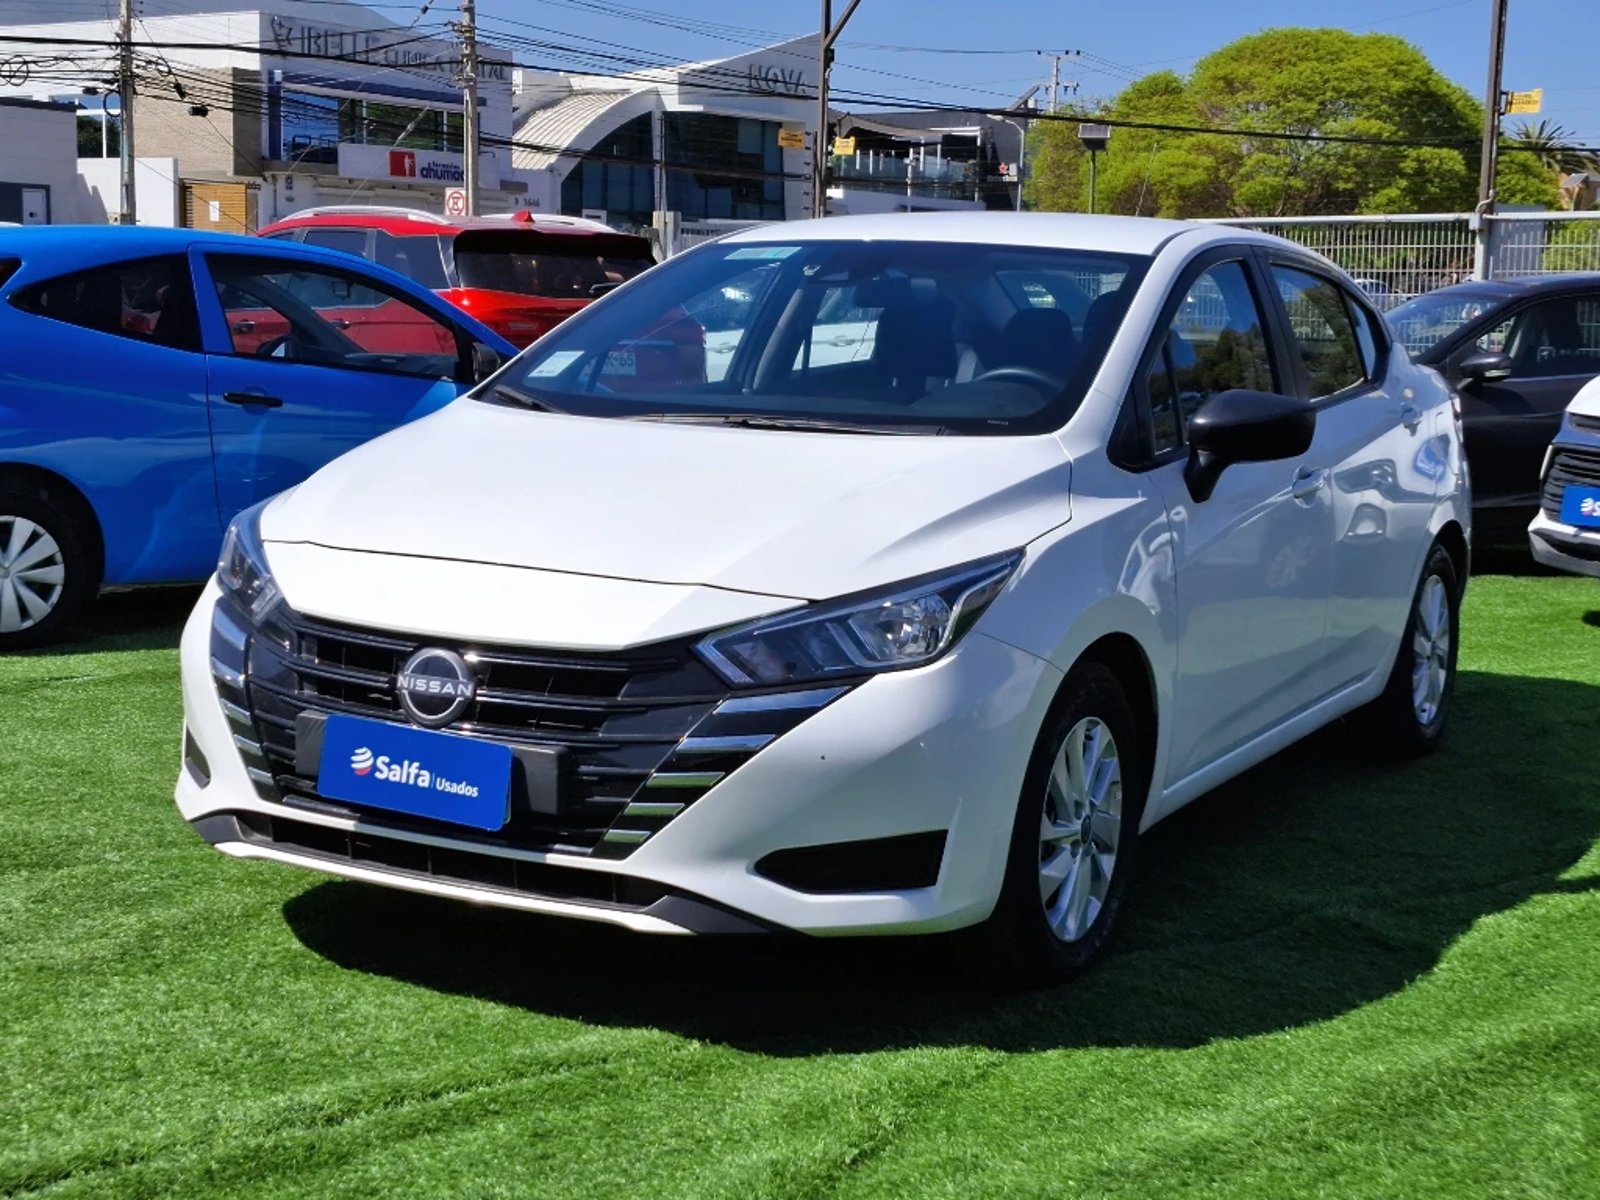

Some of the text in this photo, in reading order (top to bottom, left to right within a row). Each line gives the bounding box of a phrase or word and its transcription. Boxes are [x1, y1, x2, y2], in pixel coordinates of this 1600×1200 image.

[397, 674, 473, 697] NISSAN
[374, 755, 479, 798] Salfa Usados
